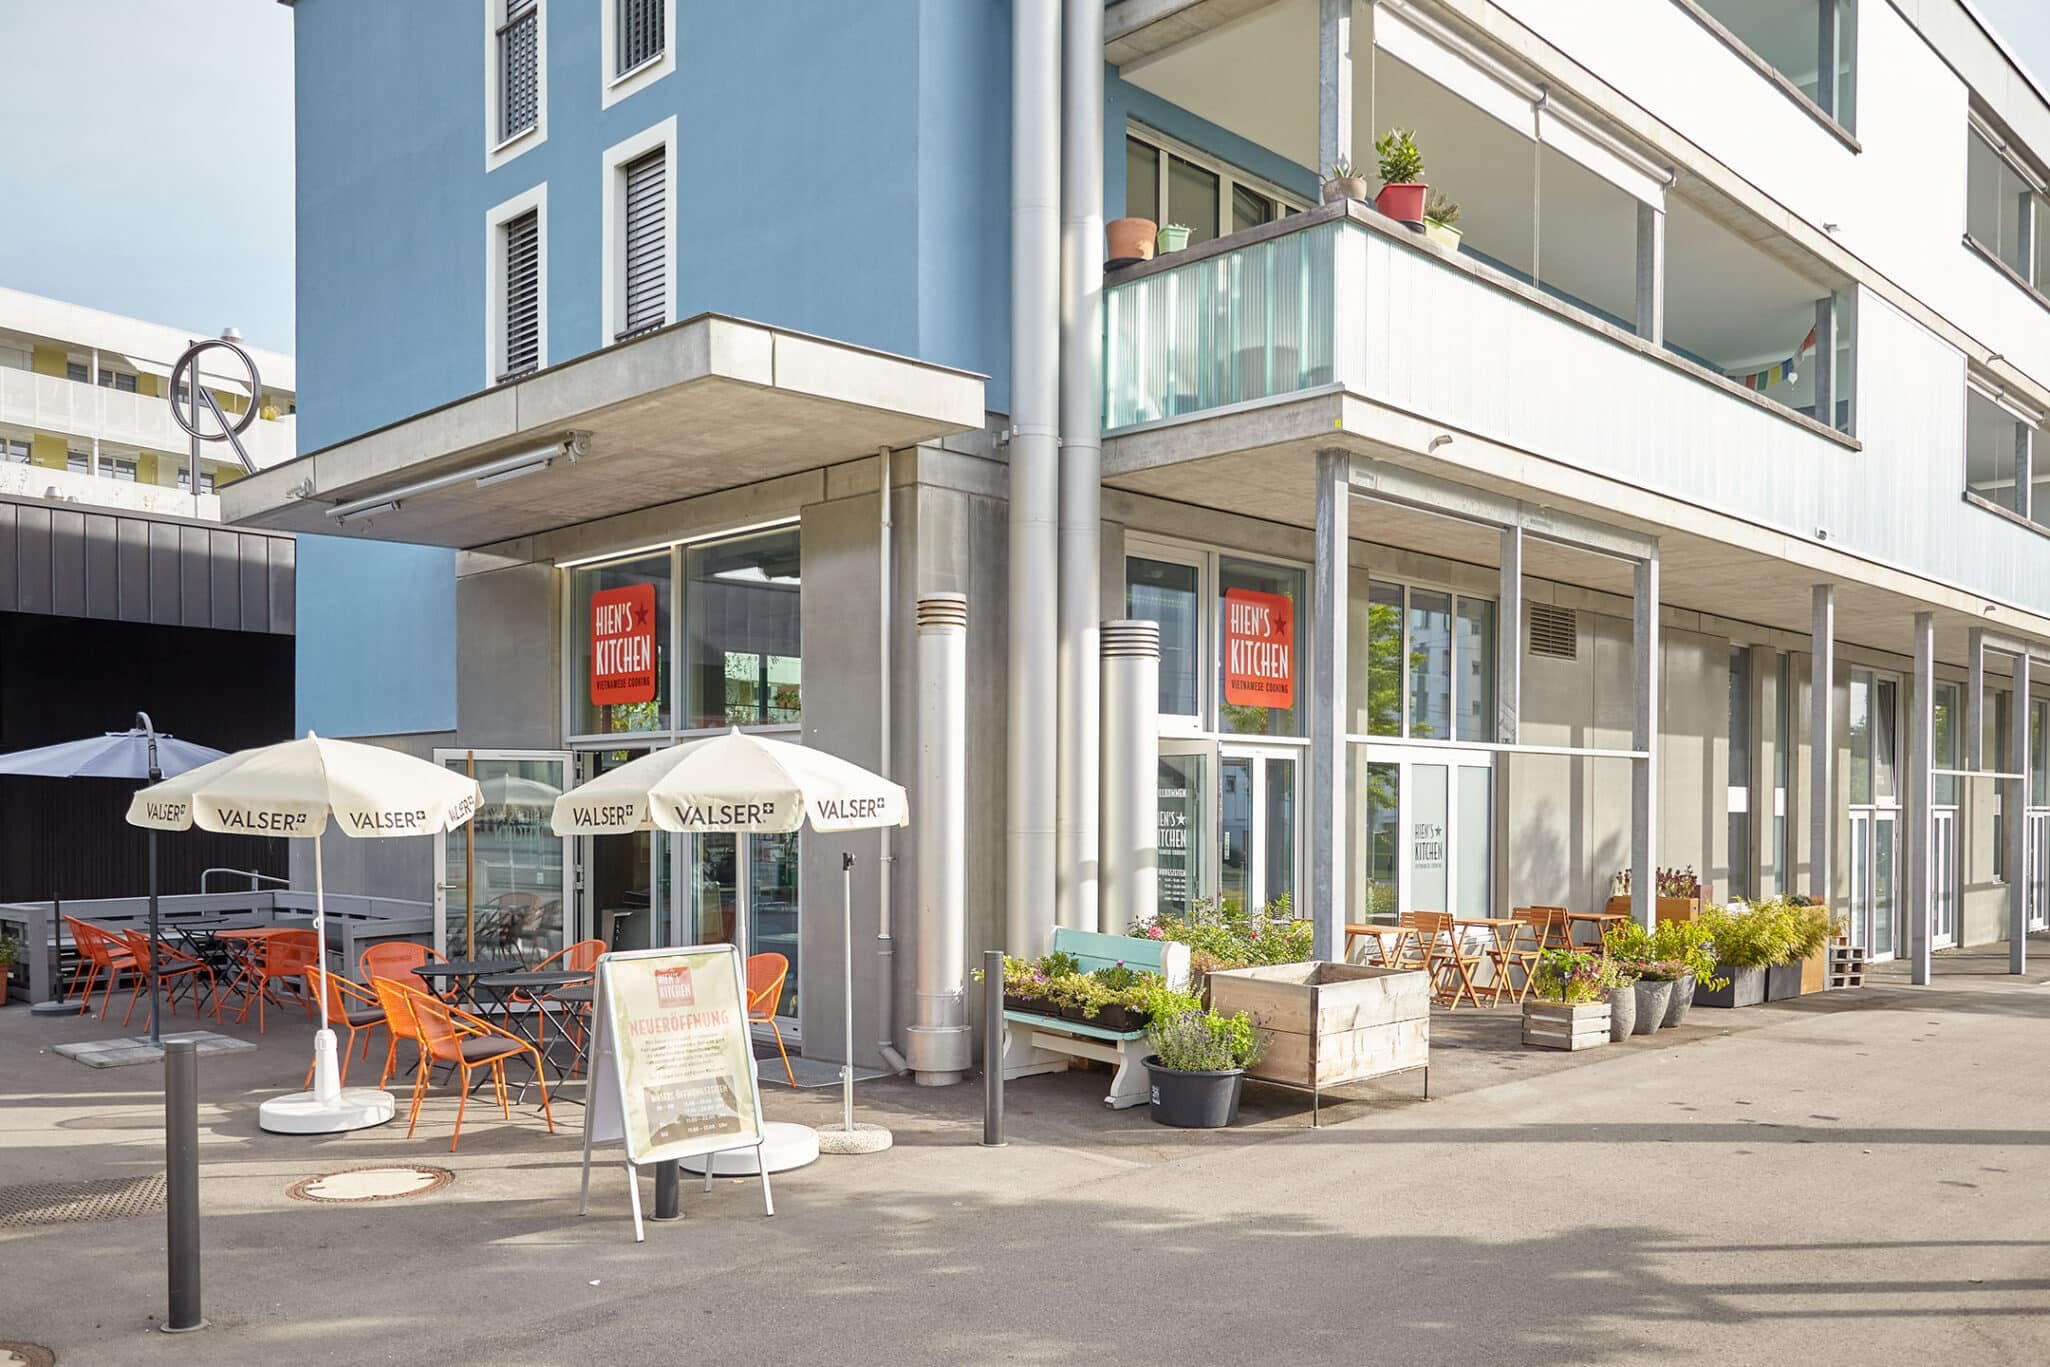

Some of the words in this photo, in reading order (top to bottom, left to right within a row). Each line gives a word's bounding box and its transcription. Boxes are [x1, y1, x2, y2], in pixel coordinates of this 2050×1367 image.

[596, 602, 633, 636] HIEN'S
[1231, 603, 1271, 638] HIEN'S
[596, 635, 651, 675] KITCHEN
[1231, 638, 1289, 679] KITCHEN
[597, 678, 627, 690] VIETNAMESE
[1231, 680, 1265, 692] VIETNAMESE
[1266, 682, 1289, 694] COOKING
[147, 802, 180, 822] VALSER
[217, 808, 296, 832] VALSER
[350, 810, 417, 830] VALSER
[573, 805, 626, 827] VALSER
[675, 803, 762, 826] VALSER
[817, 798, 877, 820] VALSER
[1415, 823, 1434, 839] HIEN'S
[1415, 841, 1442, 860] KITCHEN
[630, 1010, 730, 1035] NEUERÖFFNUNG
